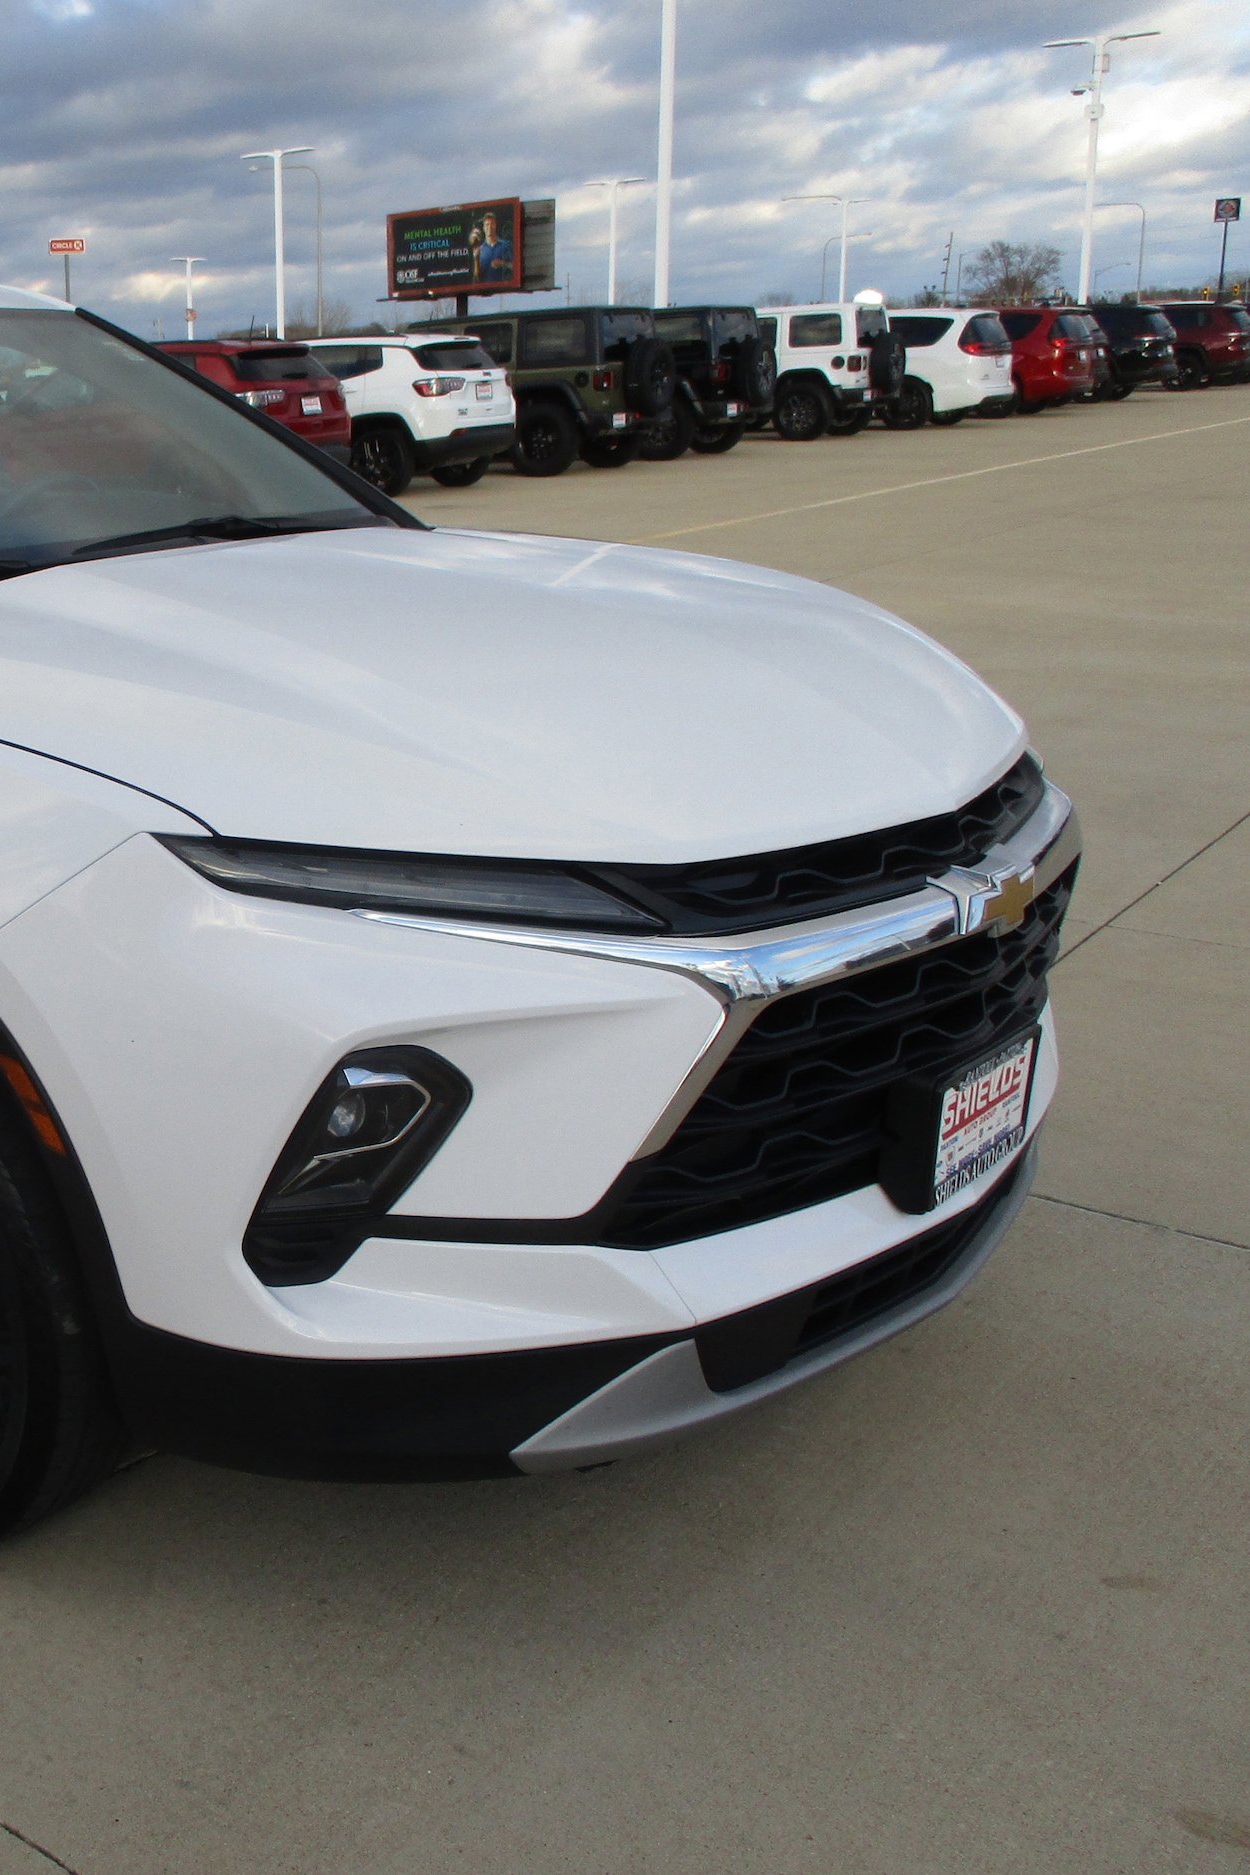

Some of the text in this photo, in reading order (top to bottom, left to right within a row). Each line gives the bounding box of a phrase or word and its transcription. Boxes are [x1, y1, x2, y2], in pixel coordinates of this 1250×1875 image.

[404, 226, 462, 240] MENTAL HEALTH
[410, 240, 450, 251] IS CRITICAL
[396, 255, 407, 263] ON
[408, 253, 422, 261] AND
[423, 251, 436, 260] OFF
[437, 249, 449, 258] THE
[943, 1054, 1026, 1129] SHIELDS
